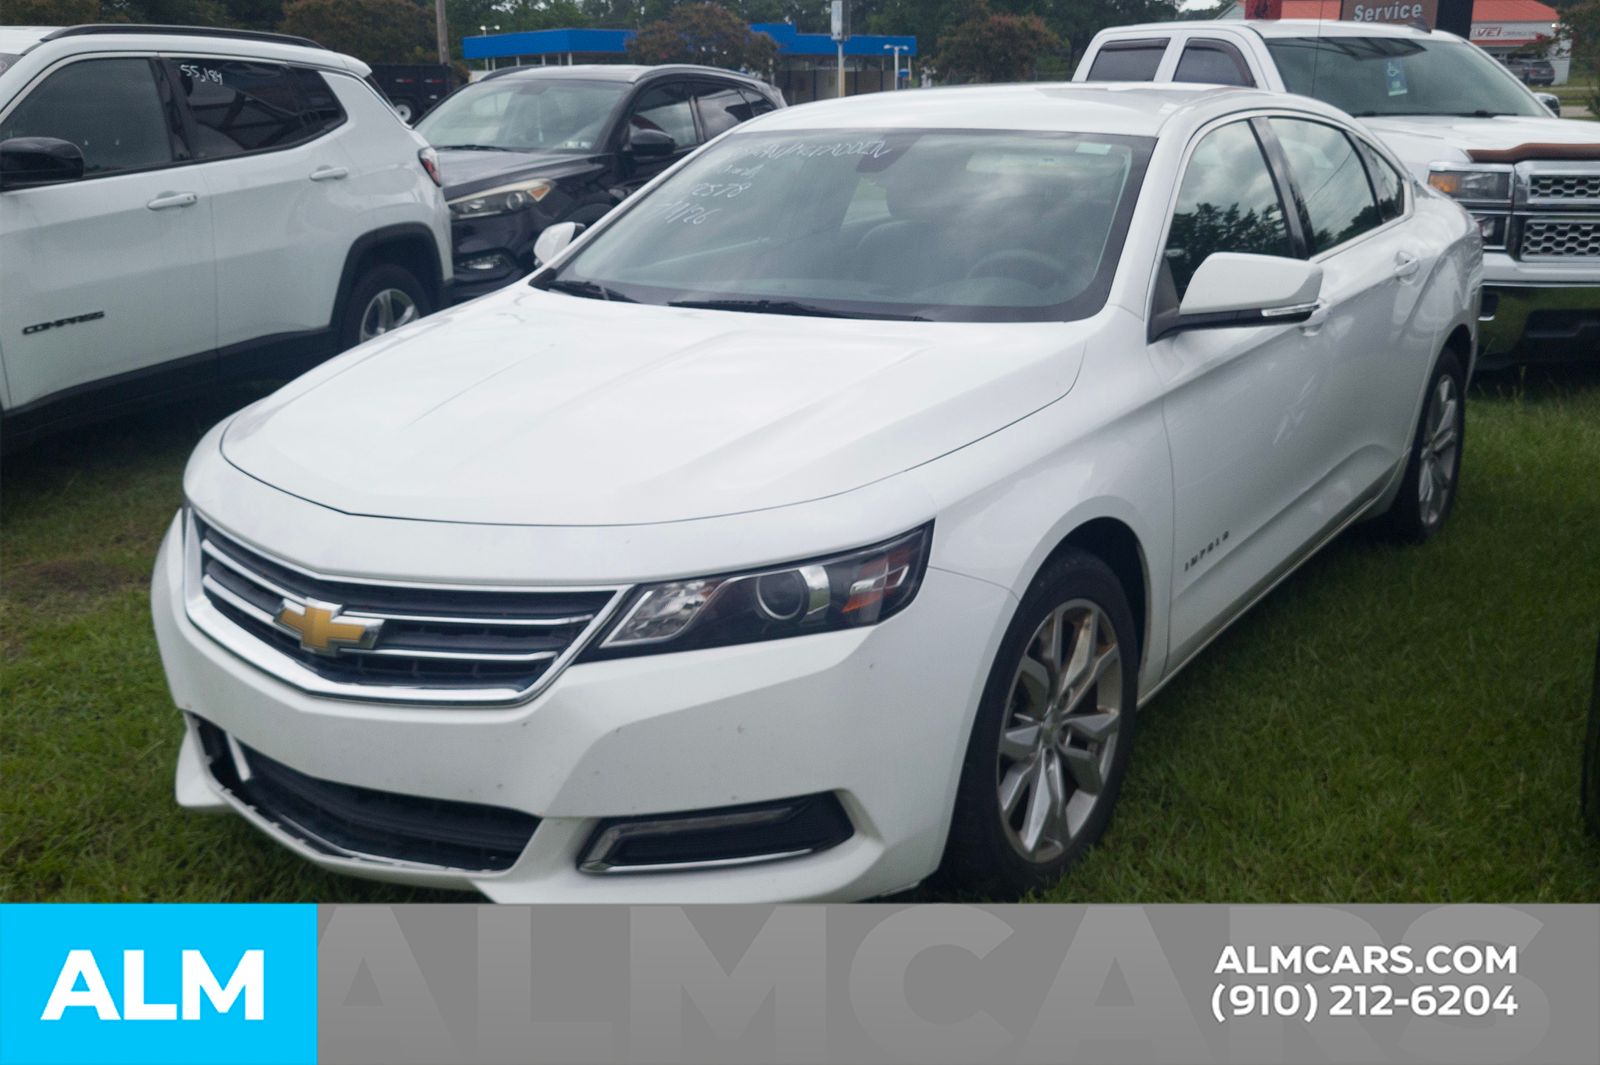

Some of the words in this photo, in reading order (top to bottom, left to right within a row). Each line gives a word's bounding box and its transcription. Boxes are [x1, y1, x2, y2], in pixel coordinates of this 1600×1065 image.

[1354, 1, 1423, 21] Service
[180, 64, 223, 85] 55,184
[22, 310, 105, 335] COMPASS
